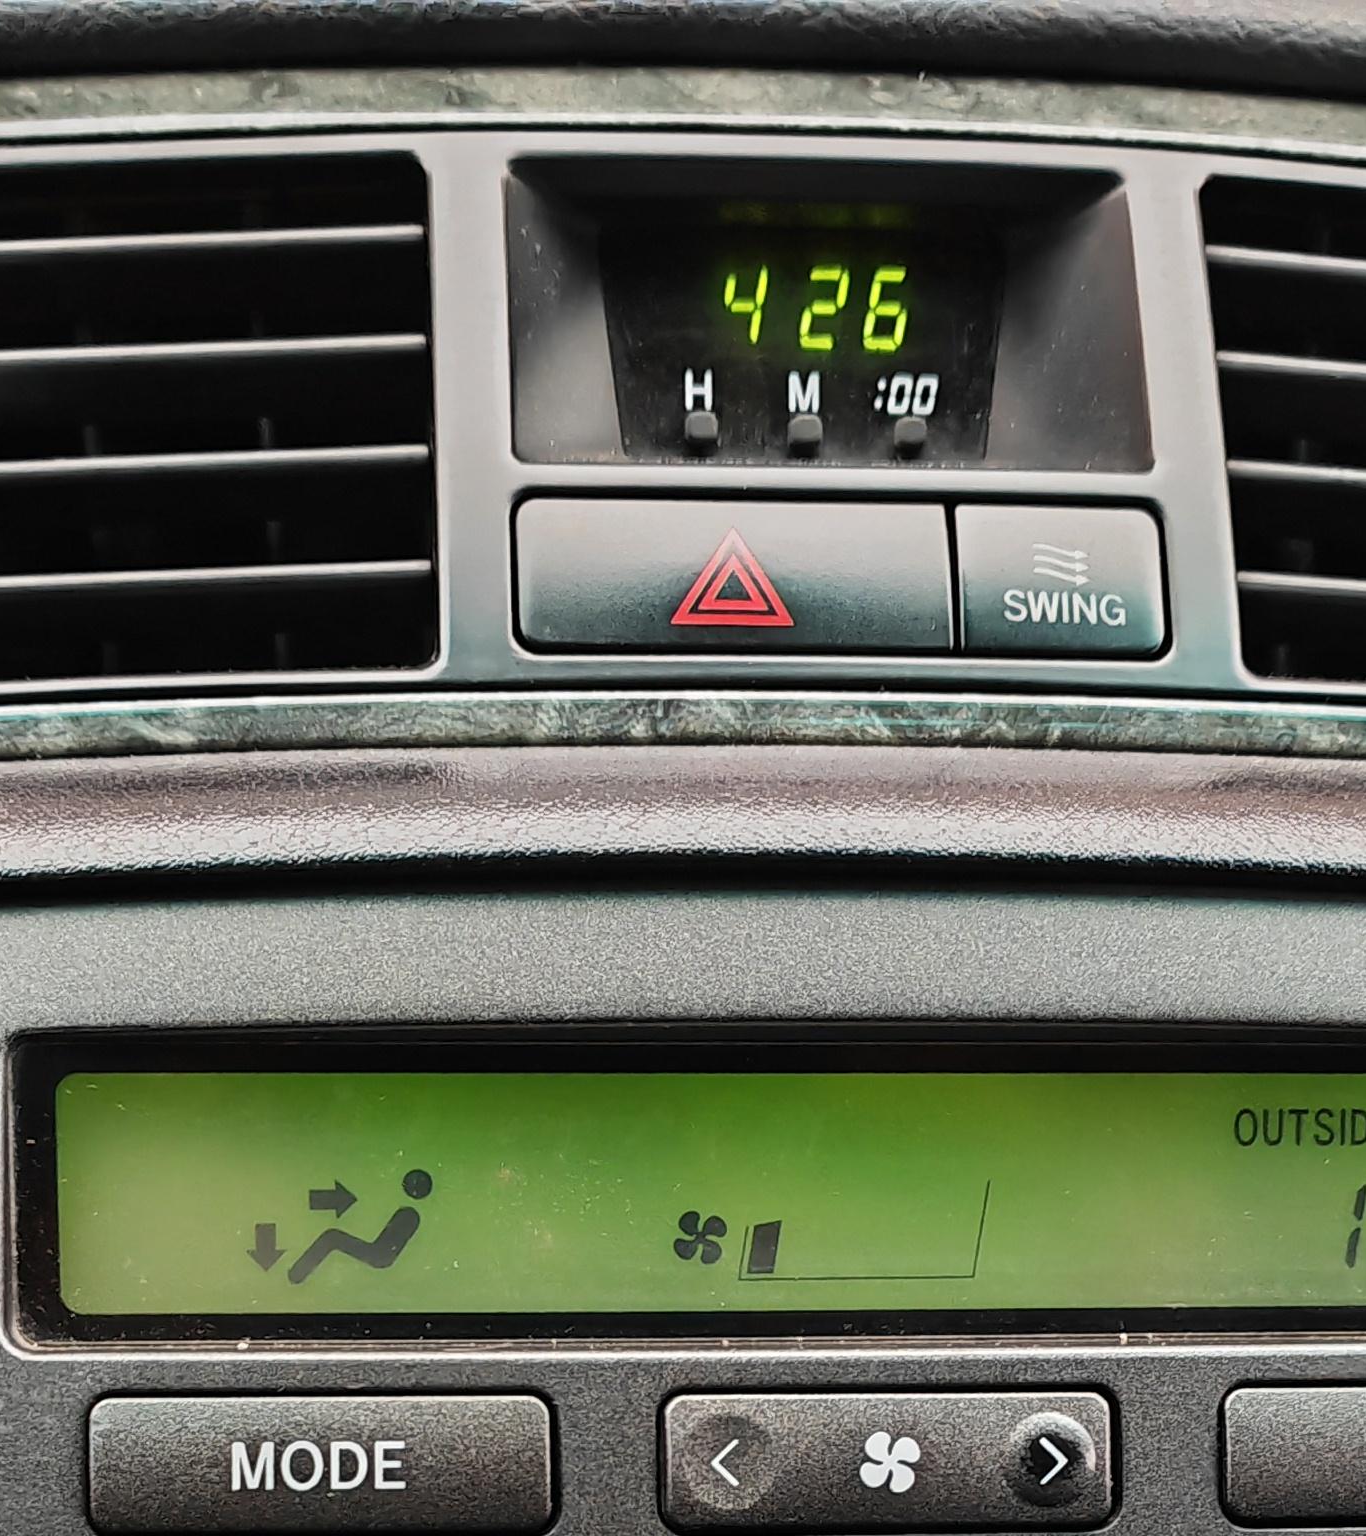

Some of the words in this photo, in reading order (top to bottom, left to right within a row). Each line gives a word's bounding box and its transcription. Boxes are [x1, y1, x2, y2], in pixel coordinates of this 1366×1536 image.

[683, 368, 714, 411] H
[787, 371, 821, 413] M
[873, 372, 939, 416] :00
[1003, 589, 1128, 629] SWING
[229, 1439, 408, 1493] MODE
